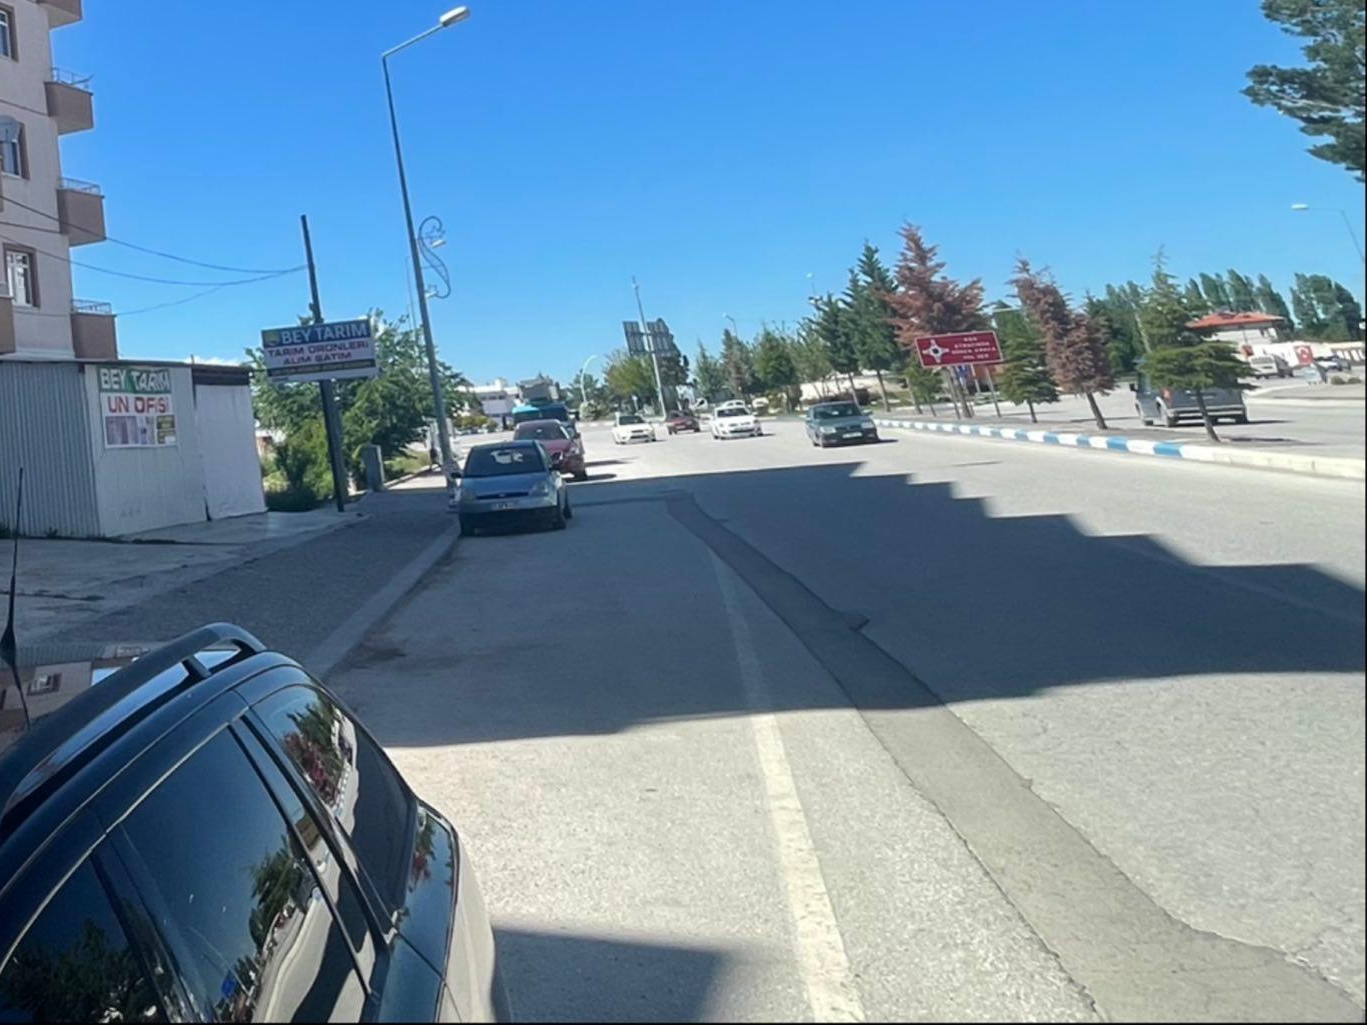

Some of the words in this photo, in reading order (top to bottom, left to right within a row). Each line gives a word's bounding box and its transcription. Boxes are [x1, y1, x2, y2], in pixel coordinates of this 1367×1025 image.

[280, 329, 312, 345] BEY
[314, 323, 368, 341] TARIM
[100, 367, 127, 390] BEY
[130, 370, 170, 391] TARIM
[107, 395, 130, 414] UN
